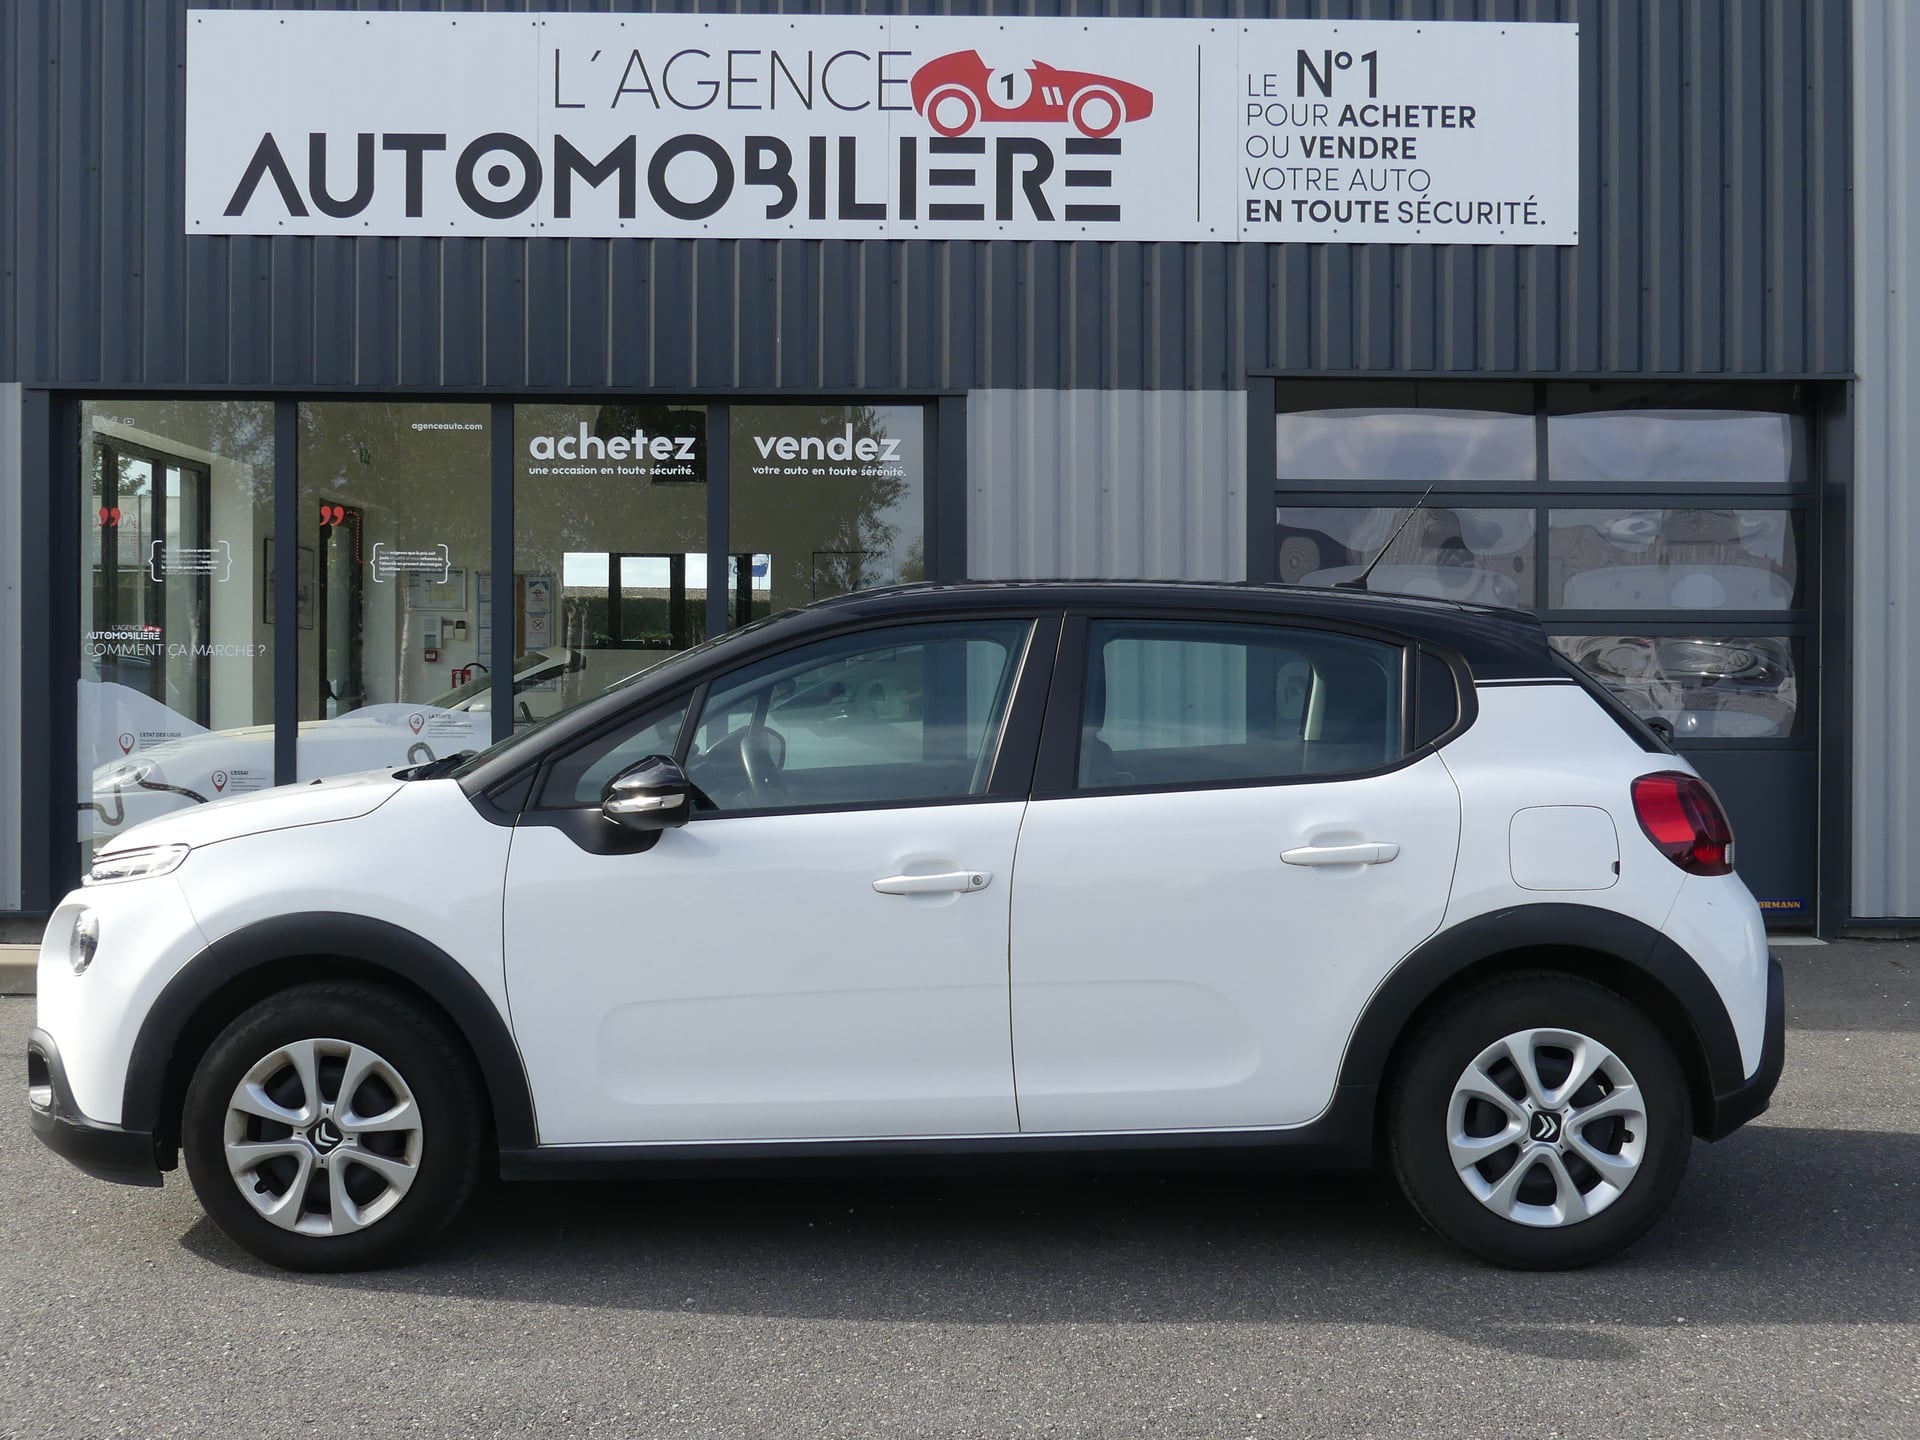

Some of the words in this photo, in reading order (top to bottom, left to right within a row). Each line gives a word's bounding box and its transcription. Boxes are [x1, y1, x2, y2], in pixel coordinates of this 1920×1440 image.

[554, 48, 913, 112] L'AGENCE
[999, 73, 1014, 101] 1
[1248, 73, 1278, 97] LE
[1247, 103, 1329, 127] POUR
[1337, 104, 1477, 129] ACHETER
[1246, 135, 1289, 159] OU
[1299, 135, 1417, 160] VENDRE
[1246, 167, 1340, 191] VOTRE
[1348, 168, 1431, 193] AUTO
[1247, 199, 1283, 223] EN
[1291, 200, 1390, 224] TOUTE
[1397, 193, 1546, 226] SÉCURITÉ.
[411, 422, 483, 432] agenceauto.com
[529, 421, 696, 460] achetez
[753, 422, 902, 462] vendez
[528, 467, 549, 475] une
[551, 464, 598, 475] occasion
[600, 467, 614, 475] en
[617, 465, 646, 475] toute
[649, 464, 695, 475] sécurité.
[752, 465, 781, 475] votre
[783, 466, 809, 475] auto
[828, 466, 858, 476] toute
[861, 465, 907, 477] sérénité.
[111, 624, 144, 632] L'AGENCE
[84, 643, 165, 657] COMMENT
[168, 643, 188, 659] ÇA
[190, 644, 255, 657] MARCHE
[258, 644, 266, 657] ?
[216, 774, 223, 783] 2
